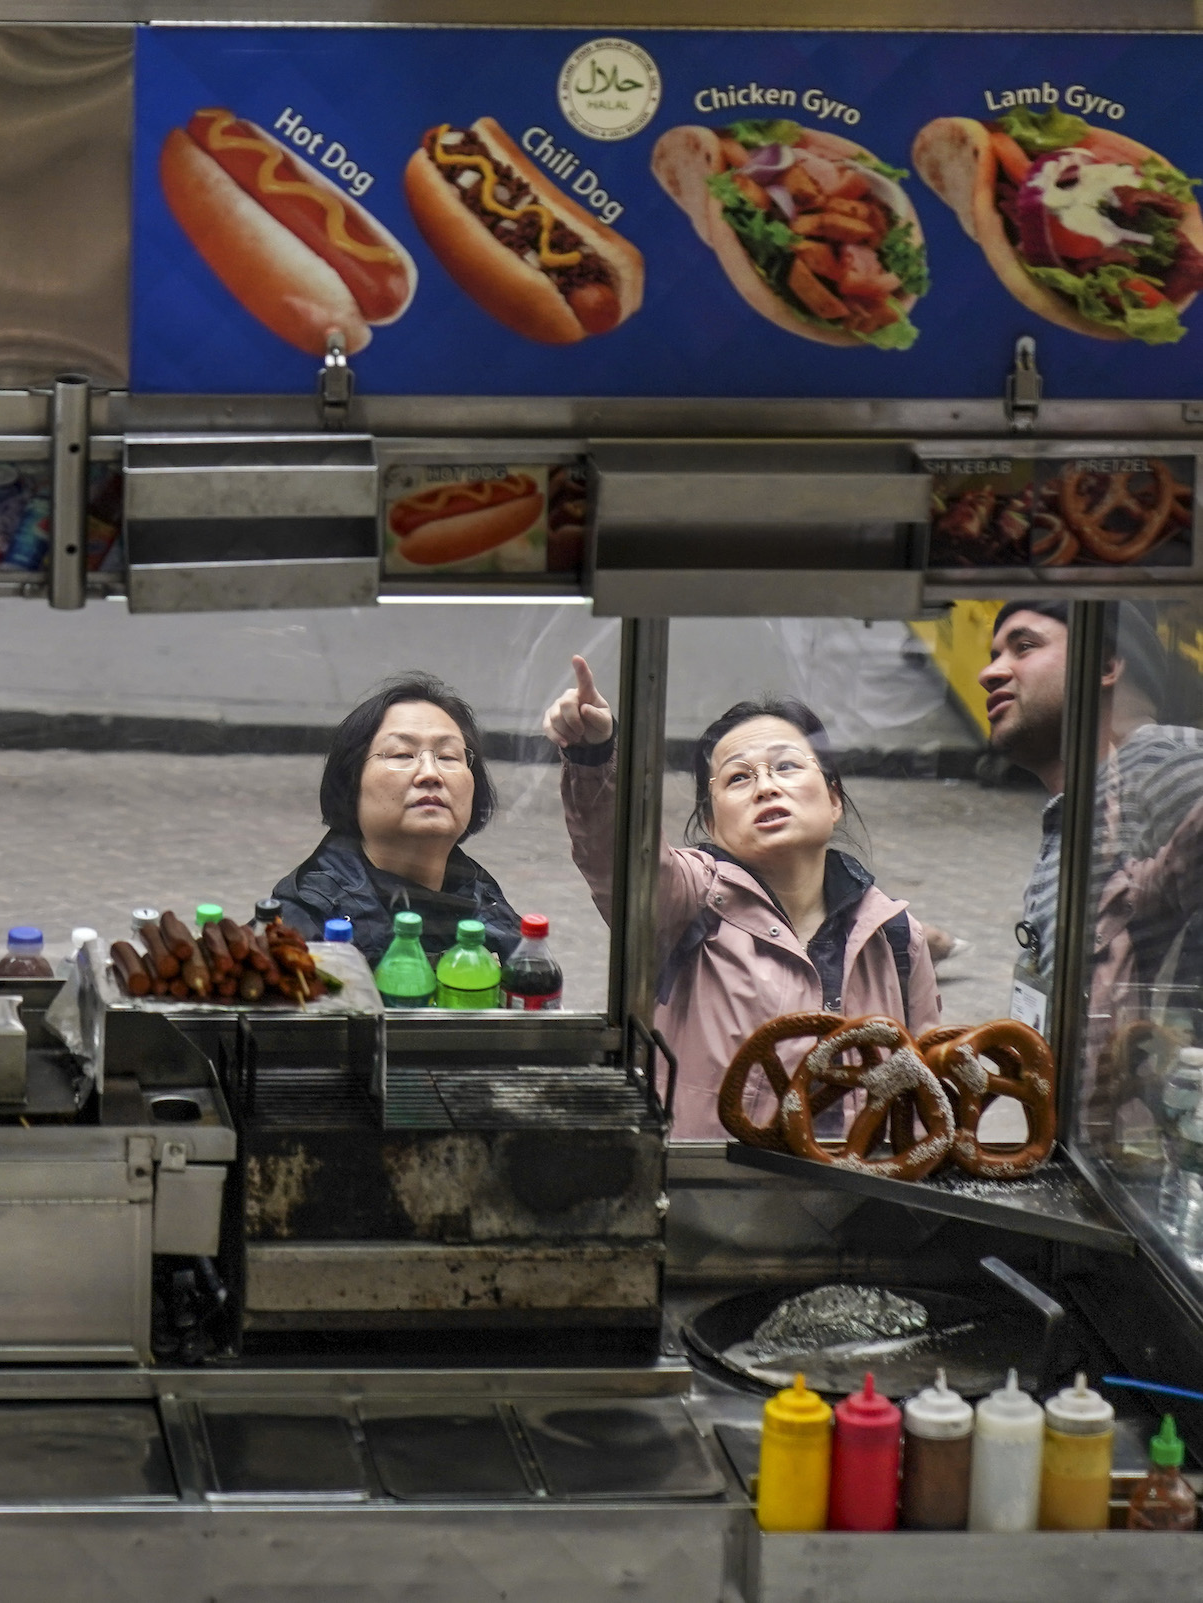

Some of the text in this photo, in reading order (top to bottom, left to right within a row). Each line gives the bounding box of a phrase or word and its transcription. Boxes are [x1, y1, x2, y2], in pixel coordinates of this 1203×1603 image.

[575, 58, 645, 94] حلال
[587, 100, 631, 111] HALAL
[693, 82, 796, 113] Chicken
[801, 89, 863, 127] Gyro
[984, 81, 1127, 122] Lamb Gyro
[273, 106, 377, 198] Hot Dog
[520, 125, 626, 225] Chili Dog
[426, 465, 509, 482] HOT DOG
[951, 460, 1012, 474] KEBAB
[1074, 459, 1153, 473] PRETZEL
